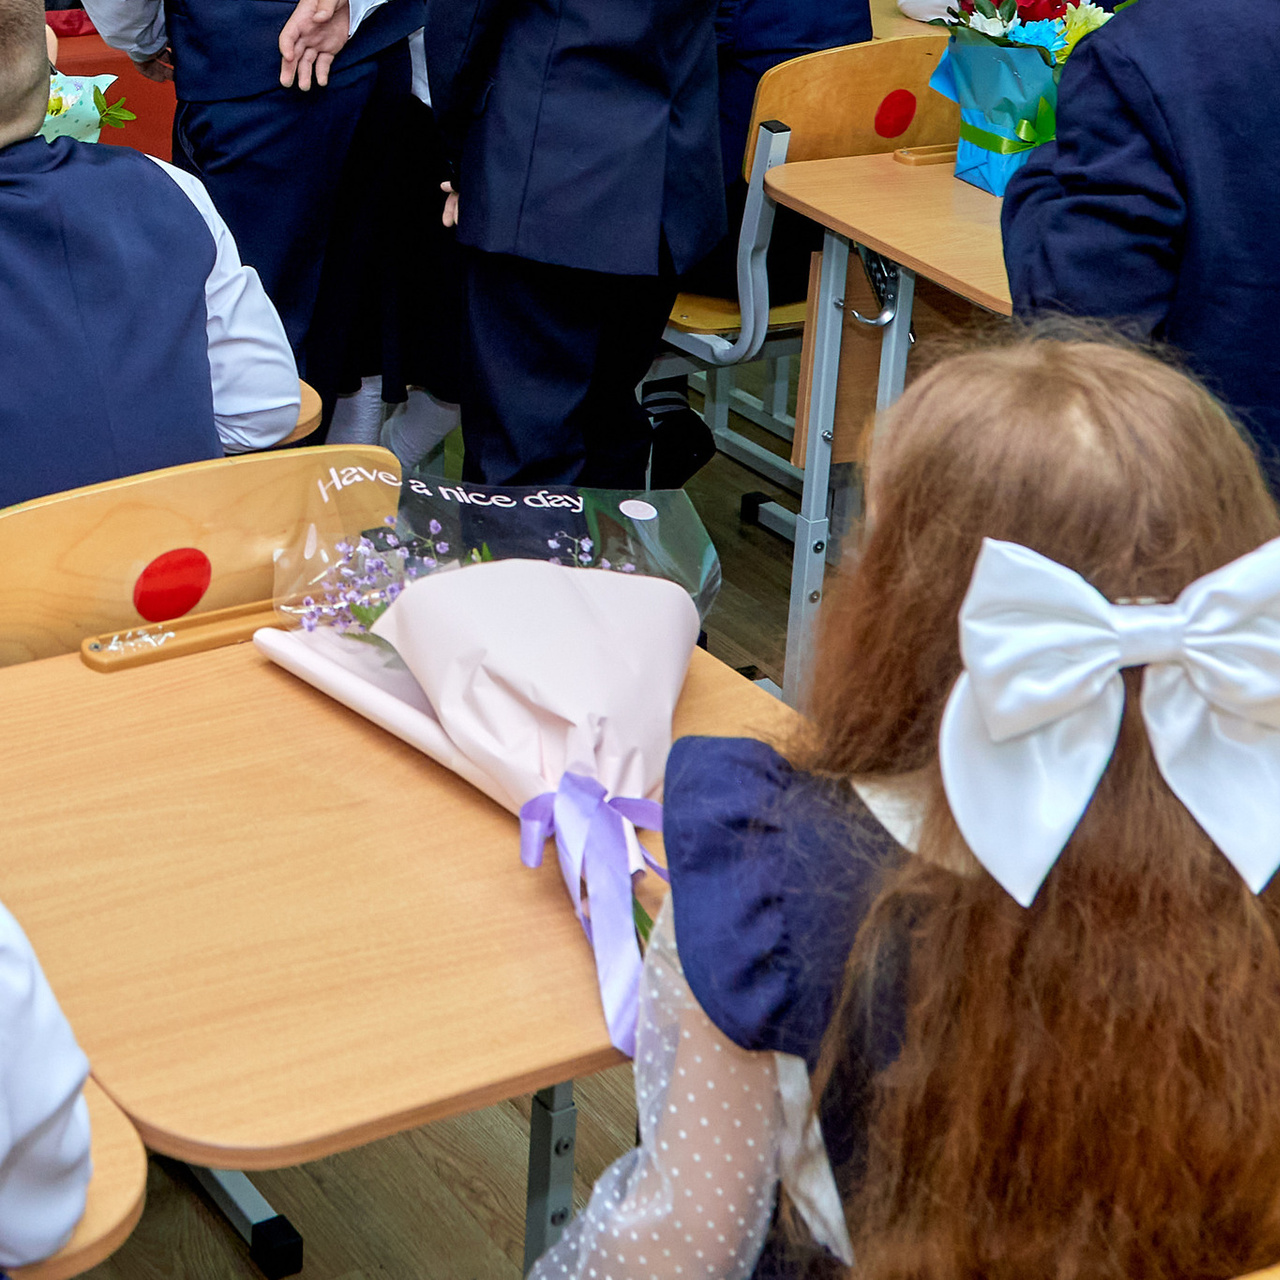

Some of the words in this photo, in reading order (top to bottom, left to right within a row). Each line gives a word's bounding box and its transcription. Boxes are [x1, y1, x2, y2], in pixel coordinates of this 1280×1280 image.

[317, 466, 403, 504] Have
[408, 478, 433, 497] a
[438, 485, 517, 508] nice
[523, 489, 584, 513] day
